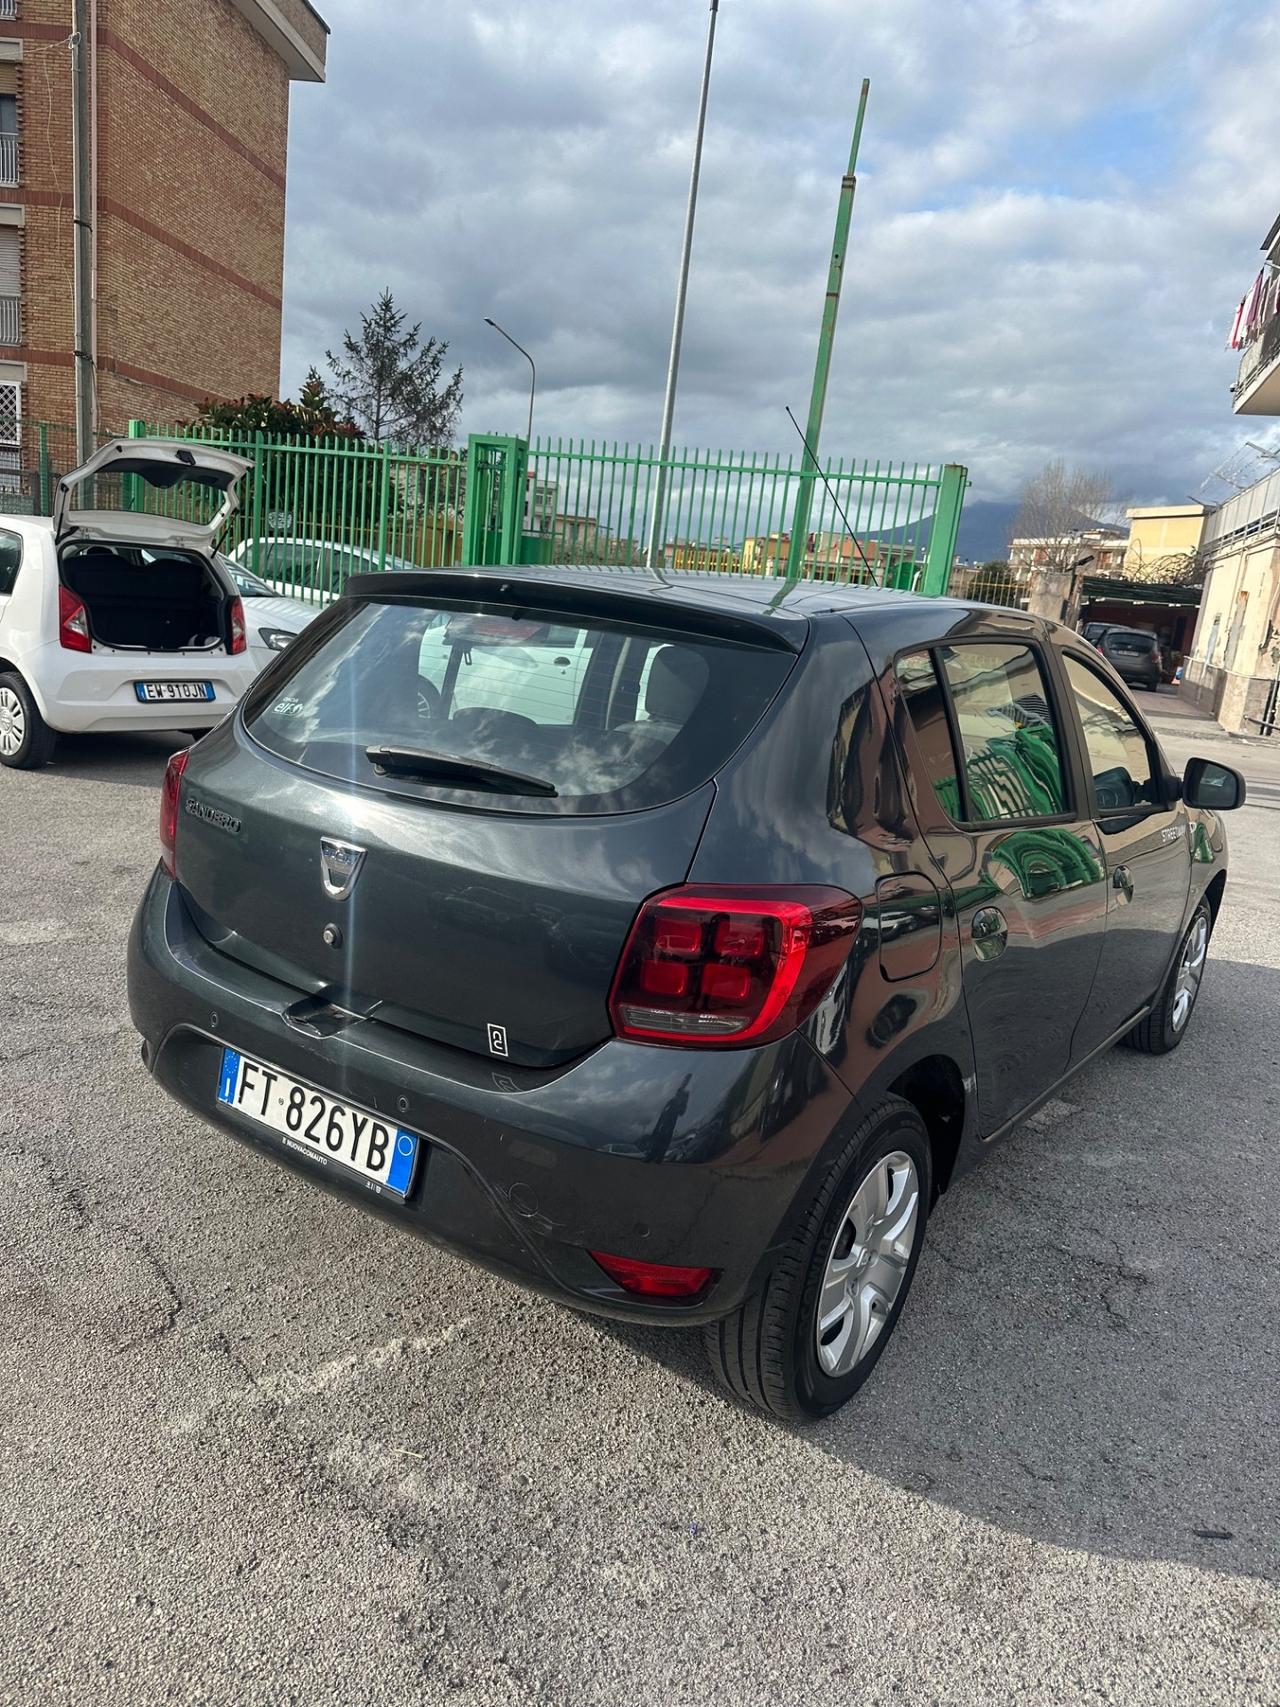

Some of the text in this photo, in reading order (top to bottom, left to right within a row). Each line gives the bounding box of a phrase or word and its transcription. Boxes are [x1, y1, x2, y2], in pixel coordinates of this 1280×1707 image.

[146, 684, 206, 698] EW 910JN
[185, 798, 242, 834] SANDERO
[238, 1061, 389, 1172] FT 826YB
